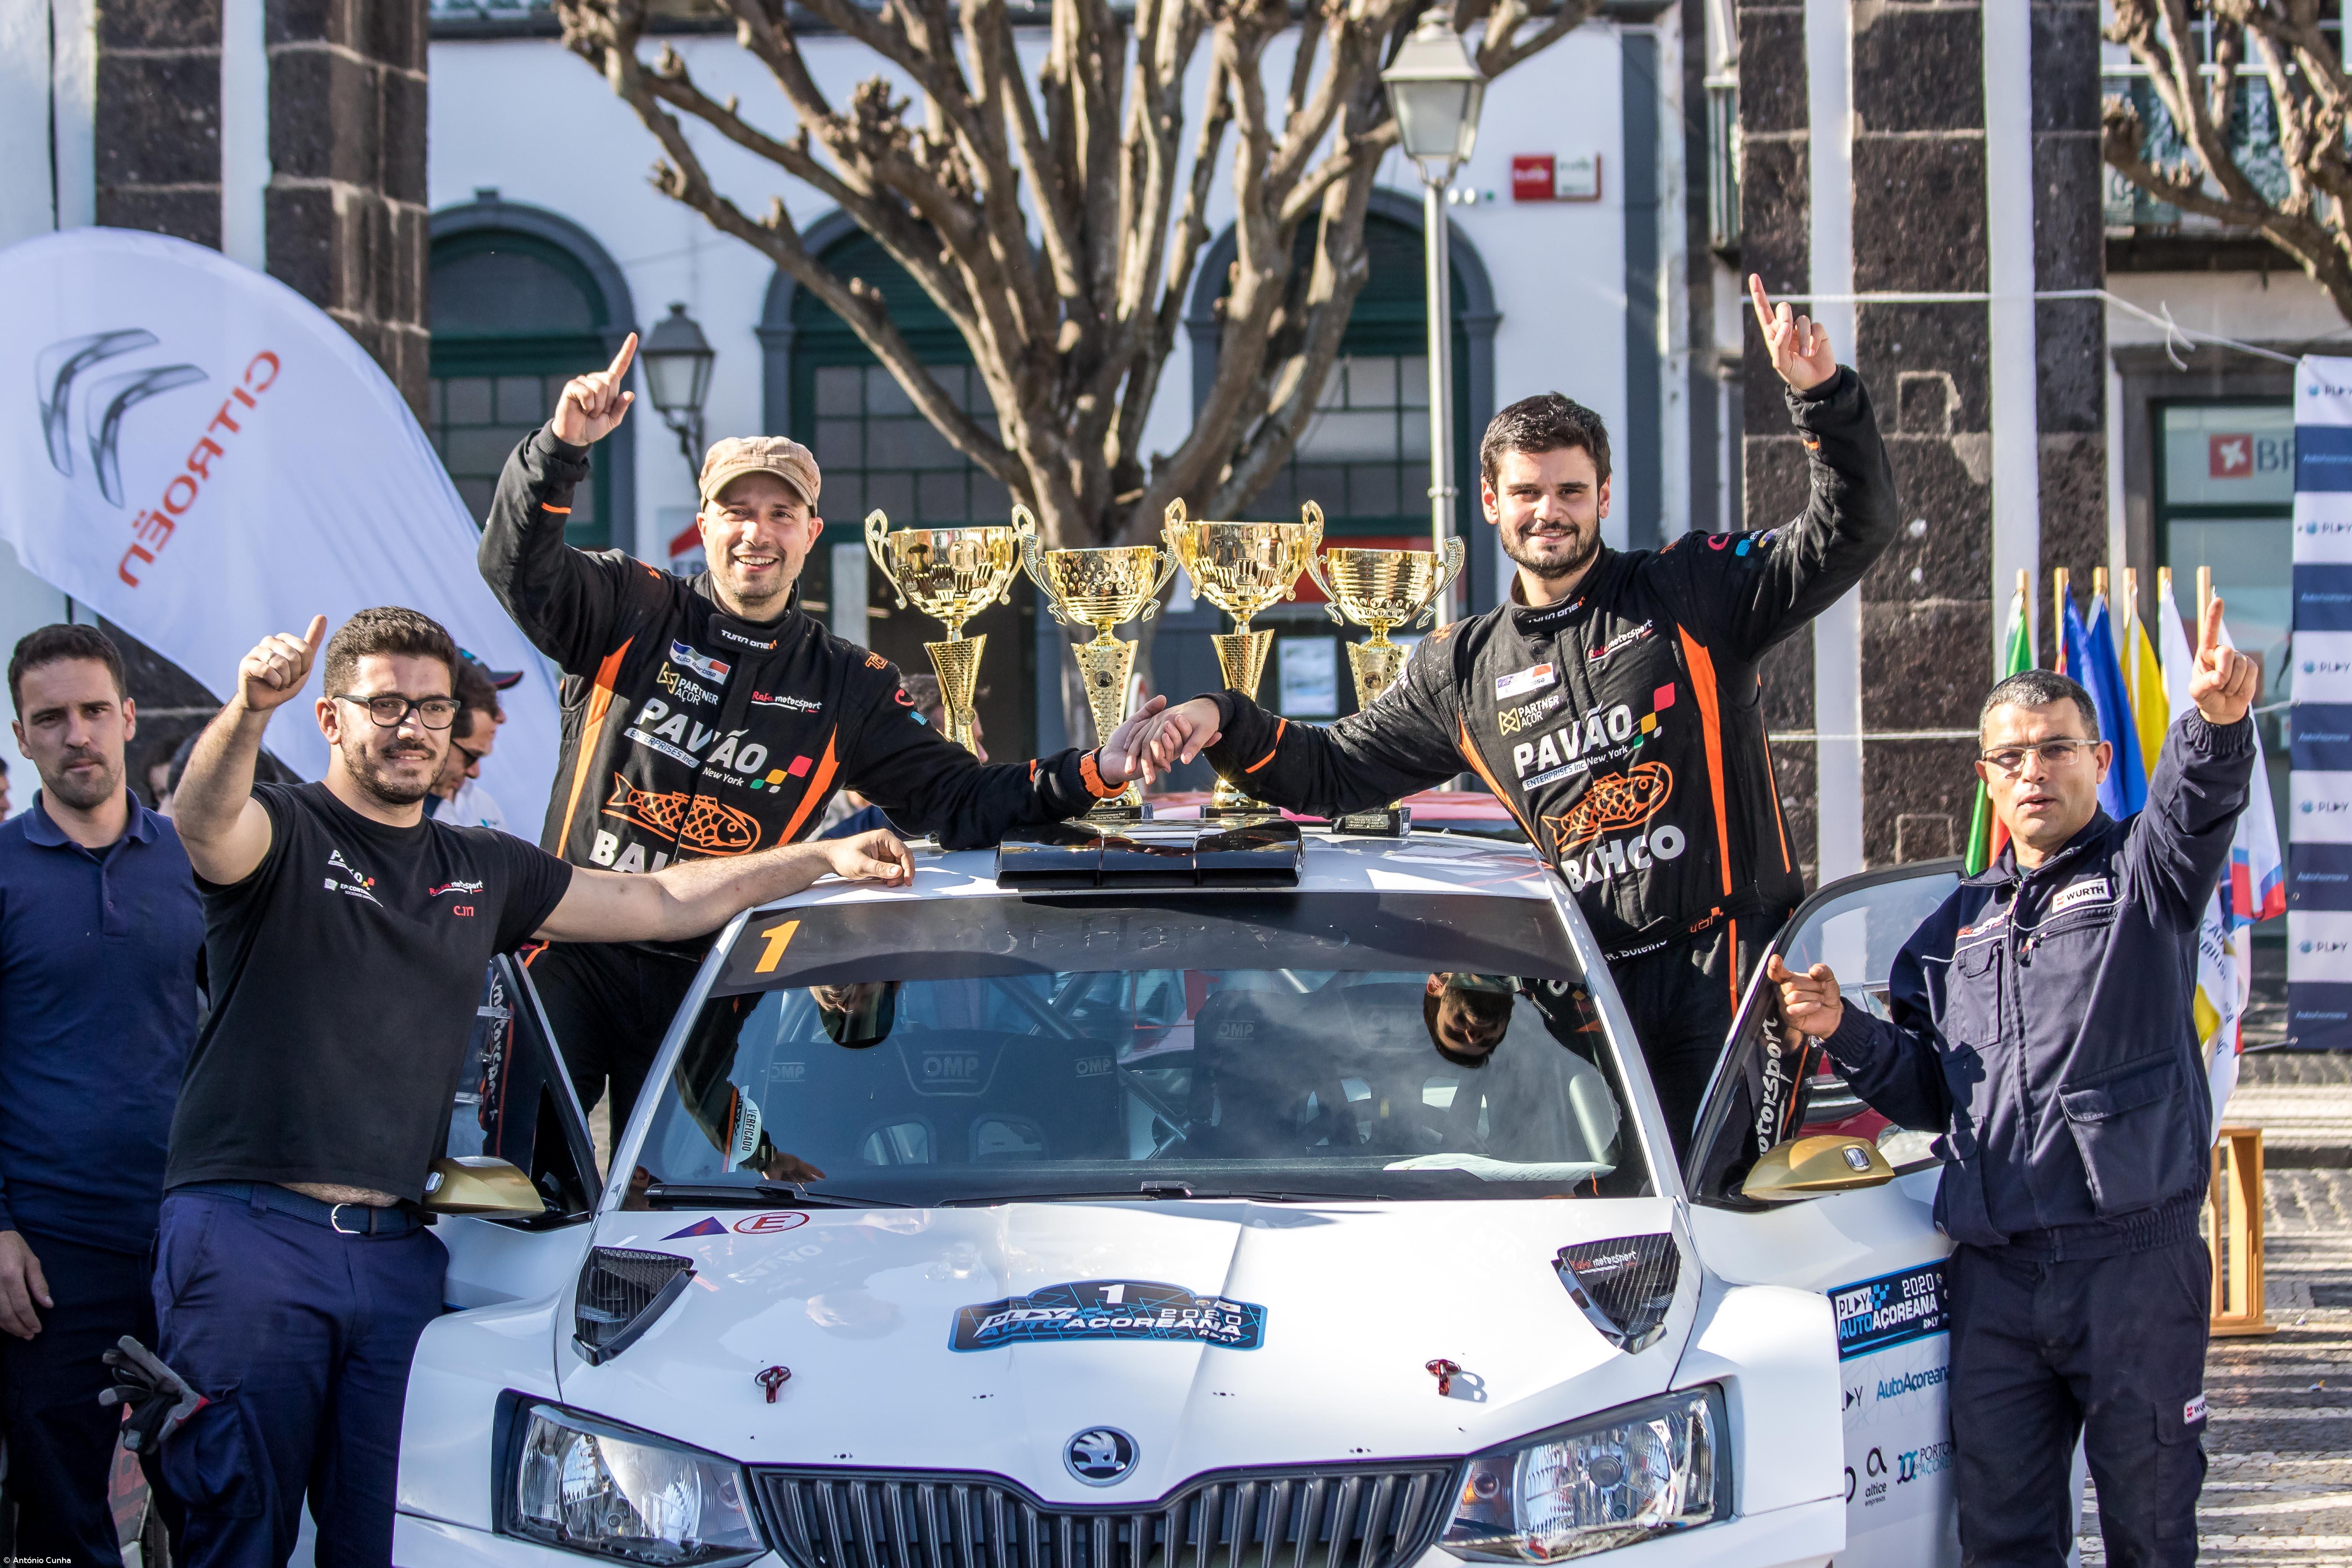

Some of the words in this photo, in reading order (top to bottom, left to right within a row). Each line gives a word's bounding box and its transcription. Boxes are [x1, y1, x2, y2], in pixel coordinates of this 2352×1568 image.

[692, 662, 716, 677] Barbosa
[674, 688, 701, 705] AÇOR
[678, 678, 718, 705] PARTNER
[1518, 695, 1559, 718] PARTNER
[1521, 711, 1543, 728] AÇOR
[634, 697, 767, 774] PAVÃO
[1514, 699, 1632, 779] PAVÃO
[1586, 754, 1606, 767] New
[1608, 744, 1629, 760] York
[702, 767, 723, 780] New
[723, 773, 745, 787] York
[1526, 764, 1573, 788] ENTERPRISES
[1561, 825, 1686, 893] BAHCO
[754, 920, 801, 973] 1
[1218, 1023, 1254, 1037] OMP
[924, 1058, 979, 1076] OMP
[1076, 1058, 1111, 1075] OMP
[1756, 1017, 1793, 1157] otorsport
[751, 1215, 792, 1230] E
[1099, 1284, 1125, 1304] 1
[1902, 1273, 1935, 1298] 2020
[1161, 1308, 1242, 1325] 2020
[1840, 1293, 1938, 1340] AUTOAÇOREANA
[1876, 1365, 1951, 1402] AutoAçorean
[1920, 1441, 1951, 1462] PORTO
